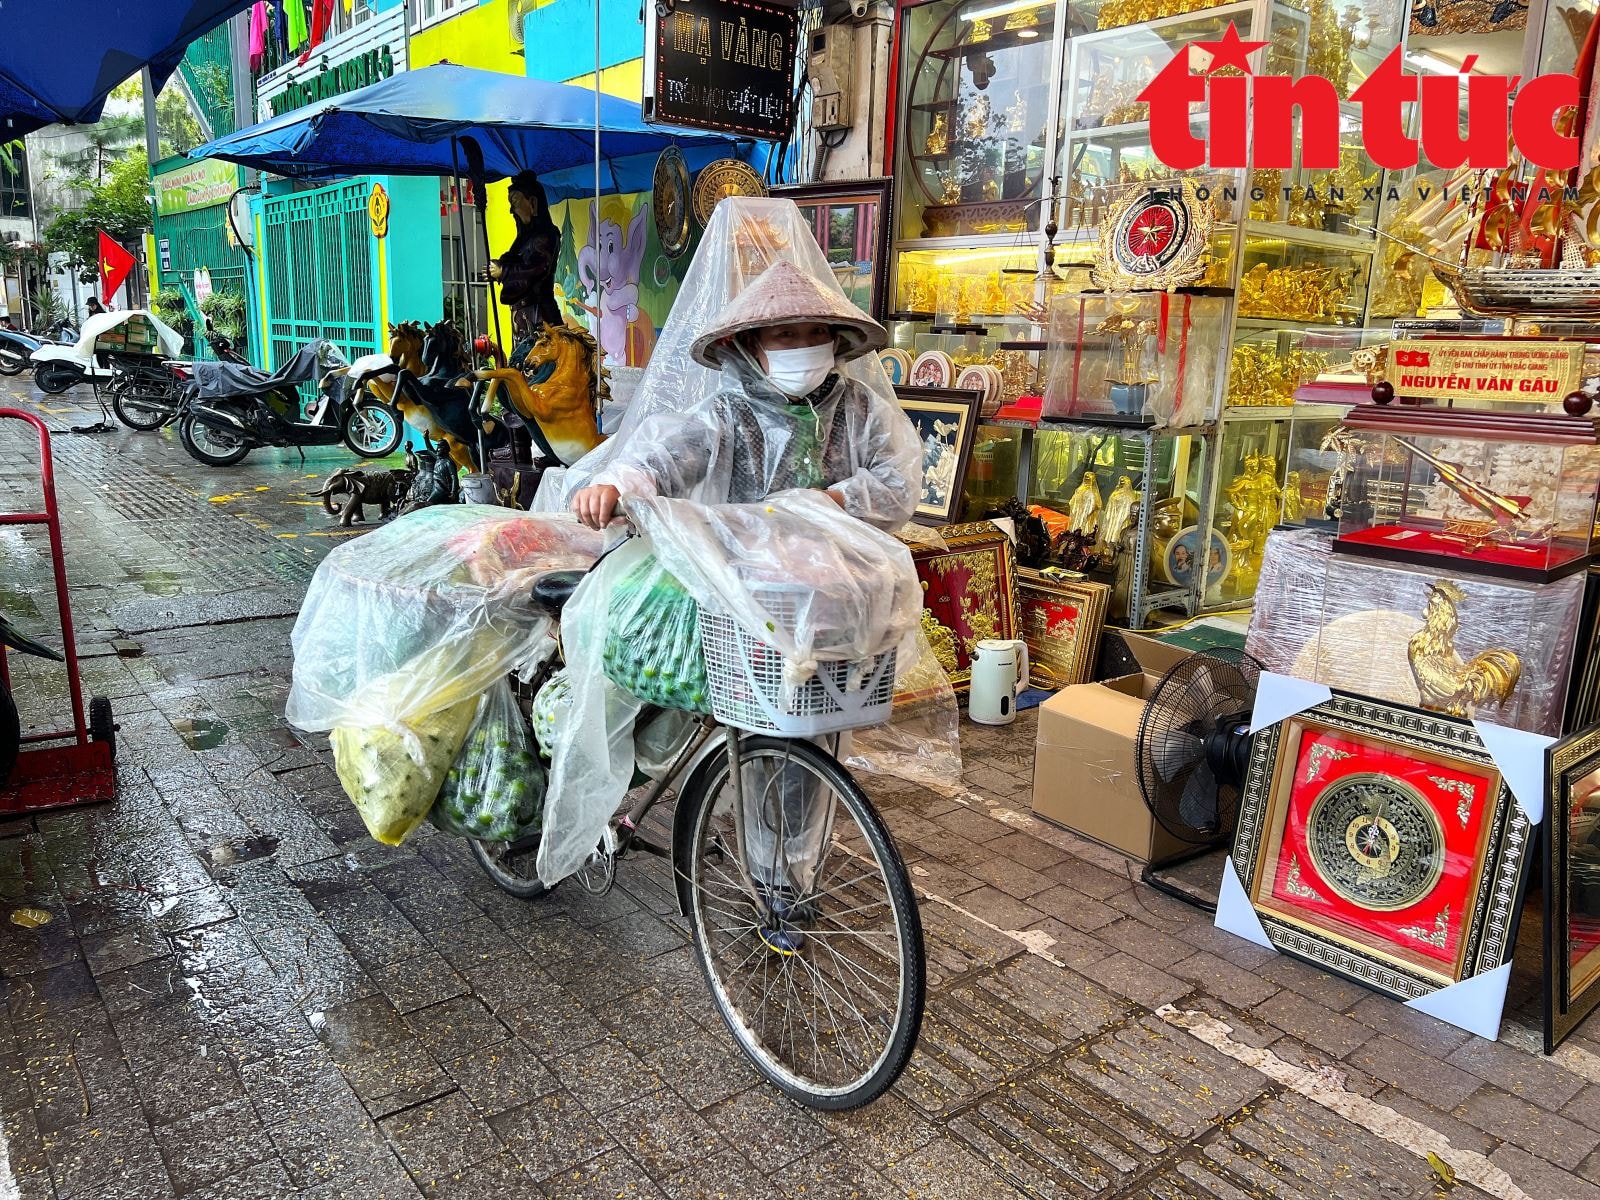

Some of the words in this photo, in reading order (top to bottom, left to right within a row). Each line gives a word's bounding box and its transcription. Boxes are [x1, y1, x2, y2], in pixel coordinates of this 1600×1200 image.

[673, 10, 712, 65] MẠ
[720, 16, 783, 71] VÀNG
[1460, 350, 1473, 358] BAN
[1401, 373, 1471, 390] NGUYỄN
[1476, 375, 1514, 391] VĂN
[1518, 375, 1559, 393] GẤU
